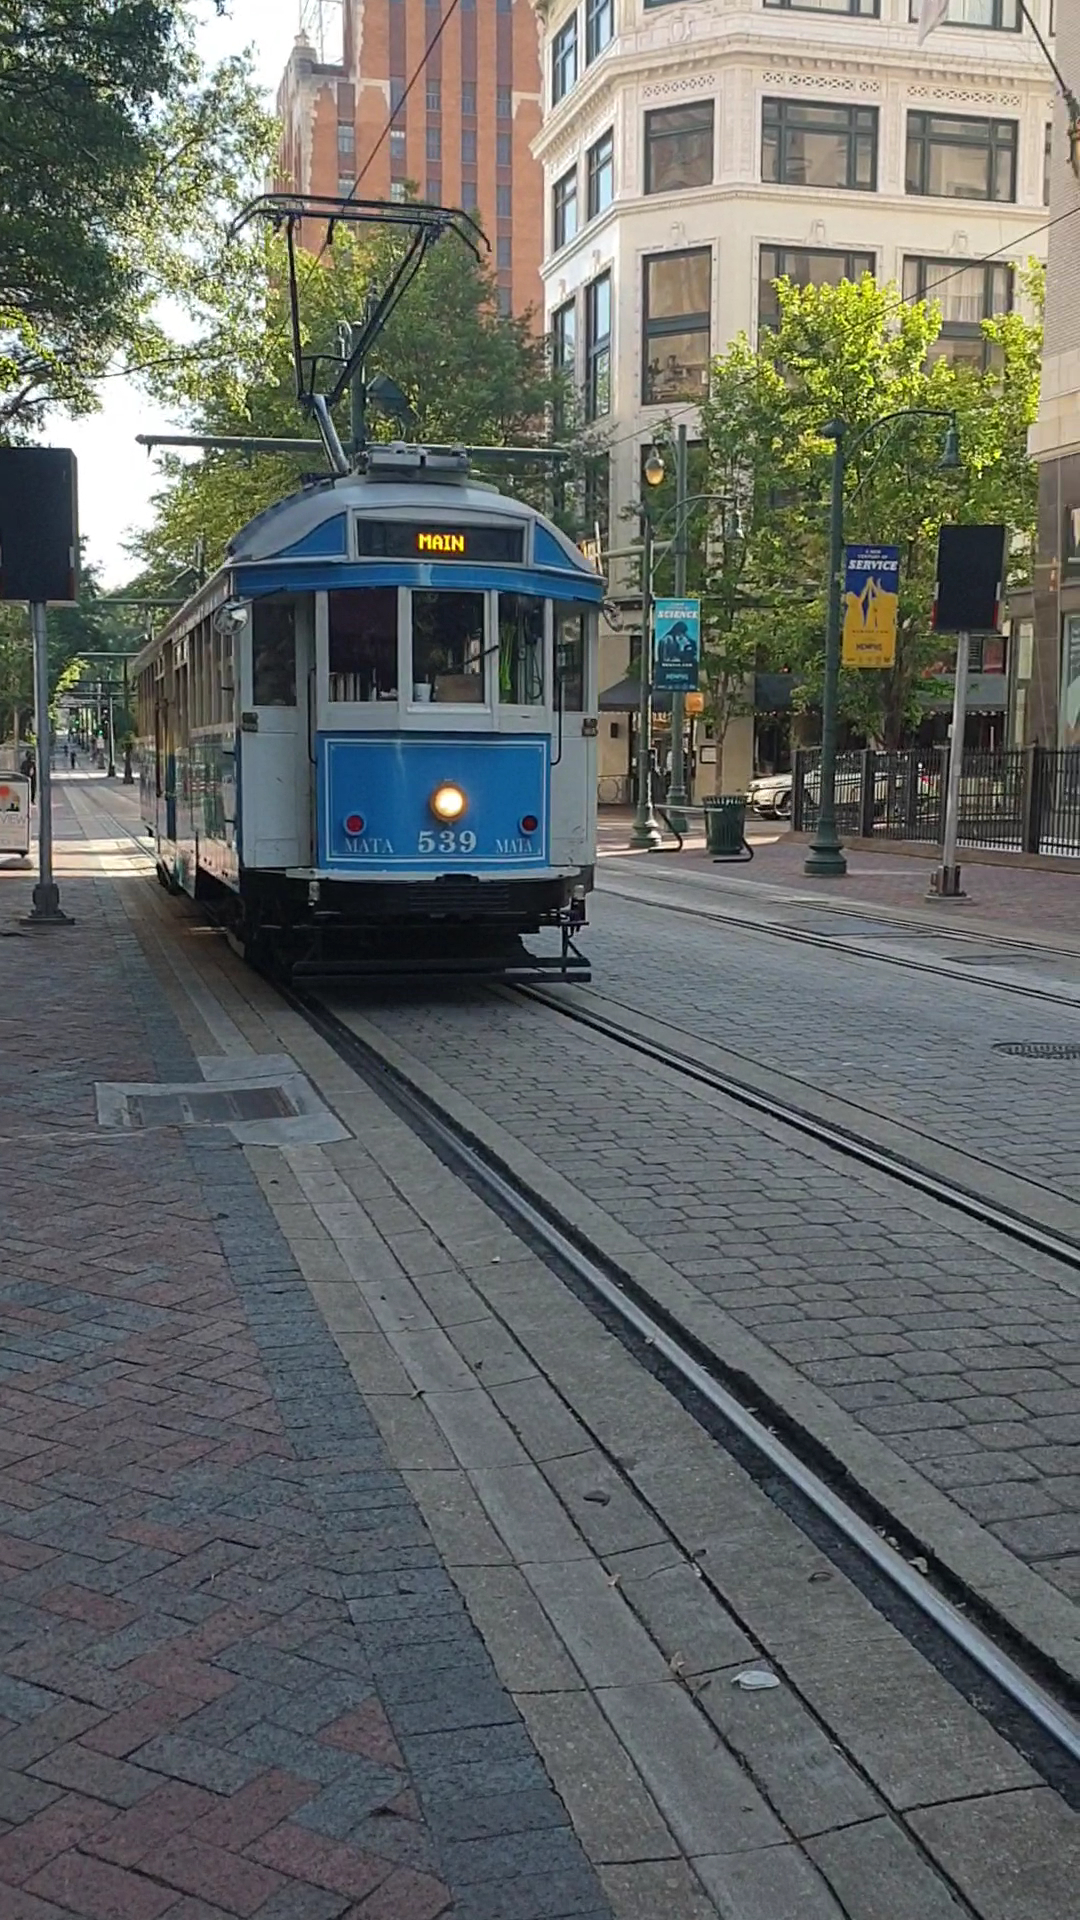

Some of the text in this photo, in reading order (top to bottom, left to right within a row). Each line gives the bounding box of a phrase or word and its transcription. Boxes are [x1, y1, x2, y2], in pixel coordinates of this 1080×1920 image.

[418, 533, 465, 552] MAIN
[848, 559, 898, 571] SERVICE
[657, 610, 698, 619] SCIENCE
[345, 838, 394, 853] MATA
[418, 830, 477, 853] 539
[495, 838, 533, 853] MATA
